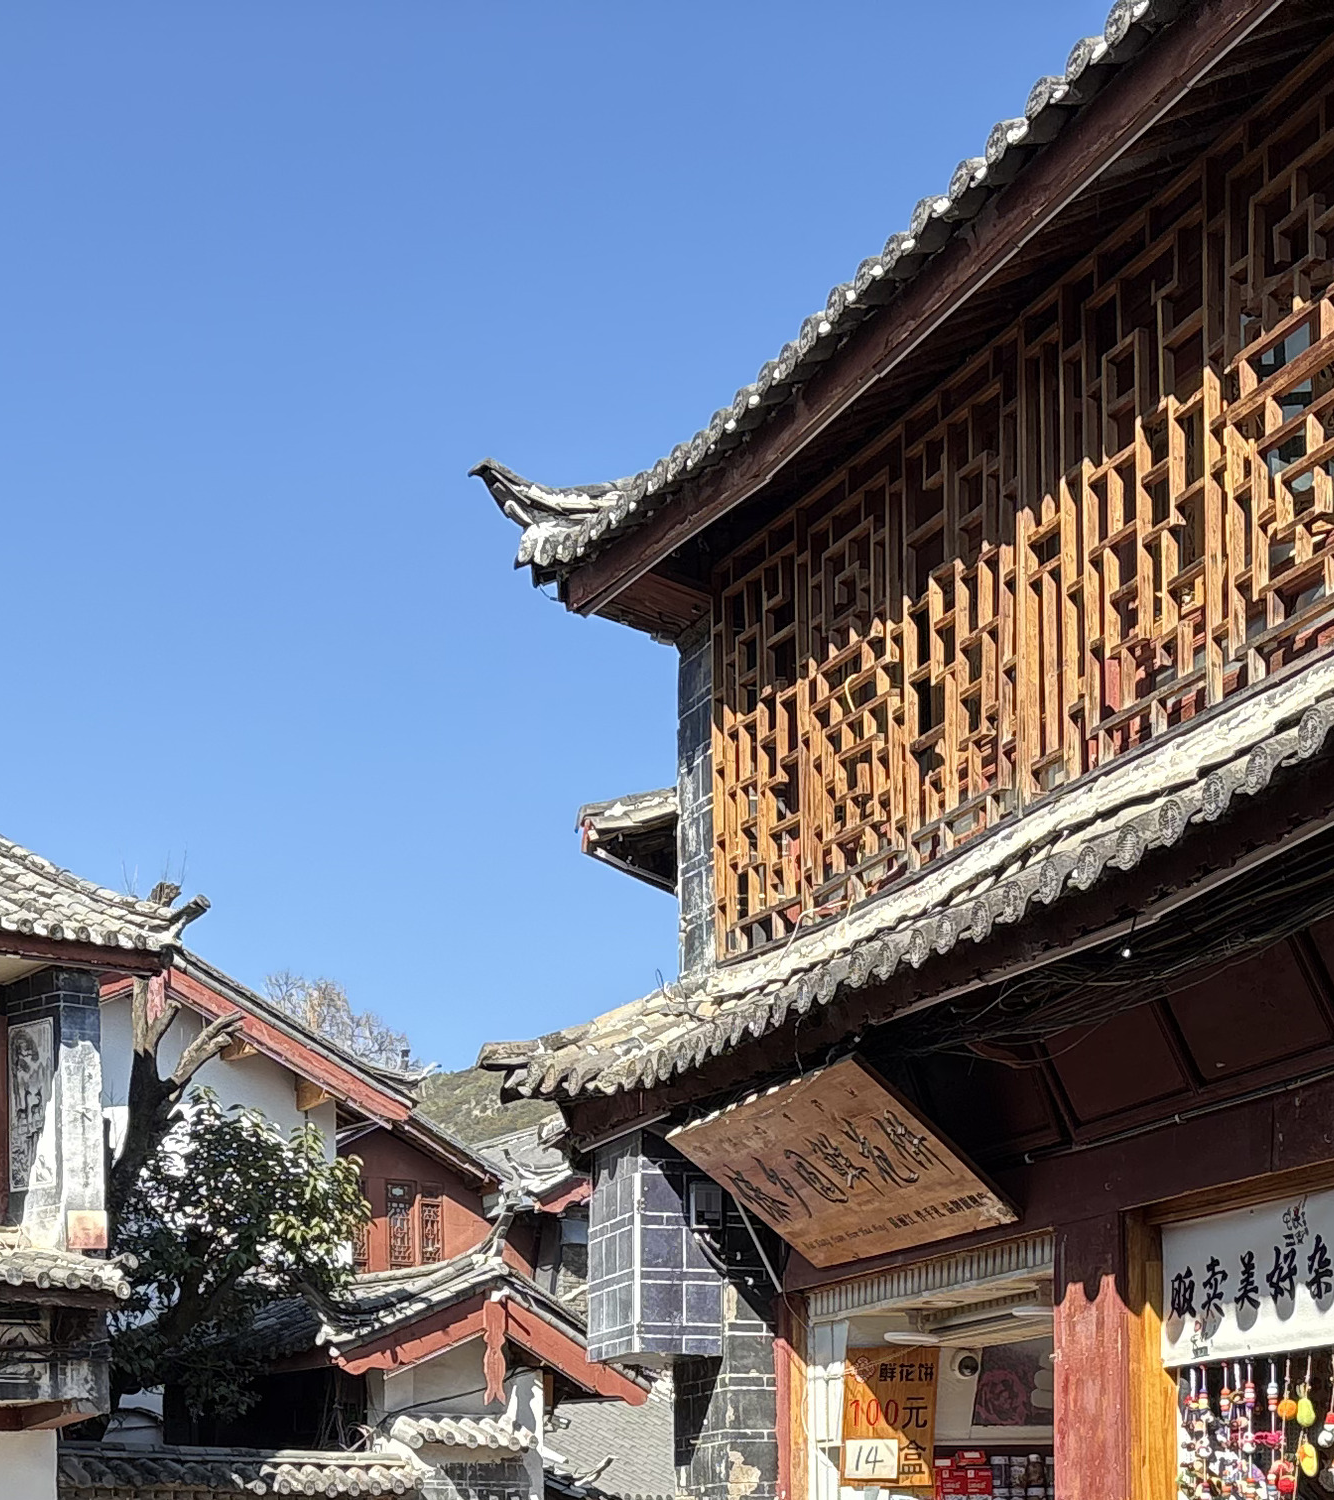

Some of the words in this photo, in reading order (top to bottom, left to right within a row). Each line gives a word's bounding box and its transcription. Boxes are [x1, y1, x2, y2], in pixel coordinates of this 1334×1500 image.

[878, 1362, 935, 1383] 鲜花饼
[849, 1396, 928, 1430] 100元
[854, 1444, 885, 1476] 14
[899, 1439, 927, 1476] 盒
